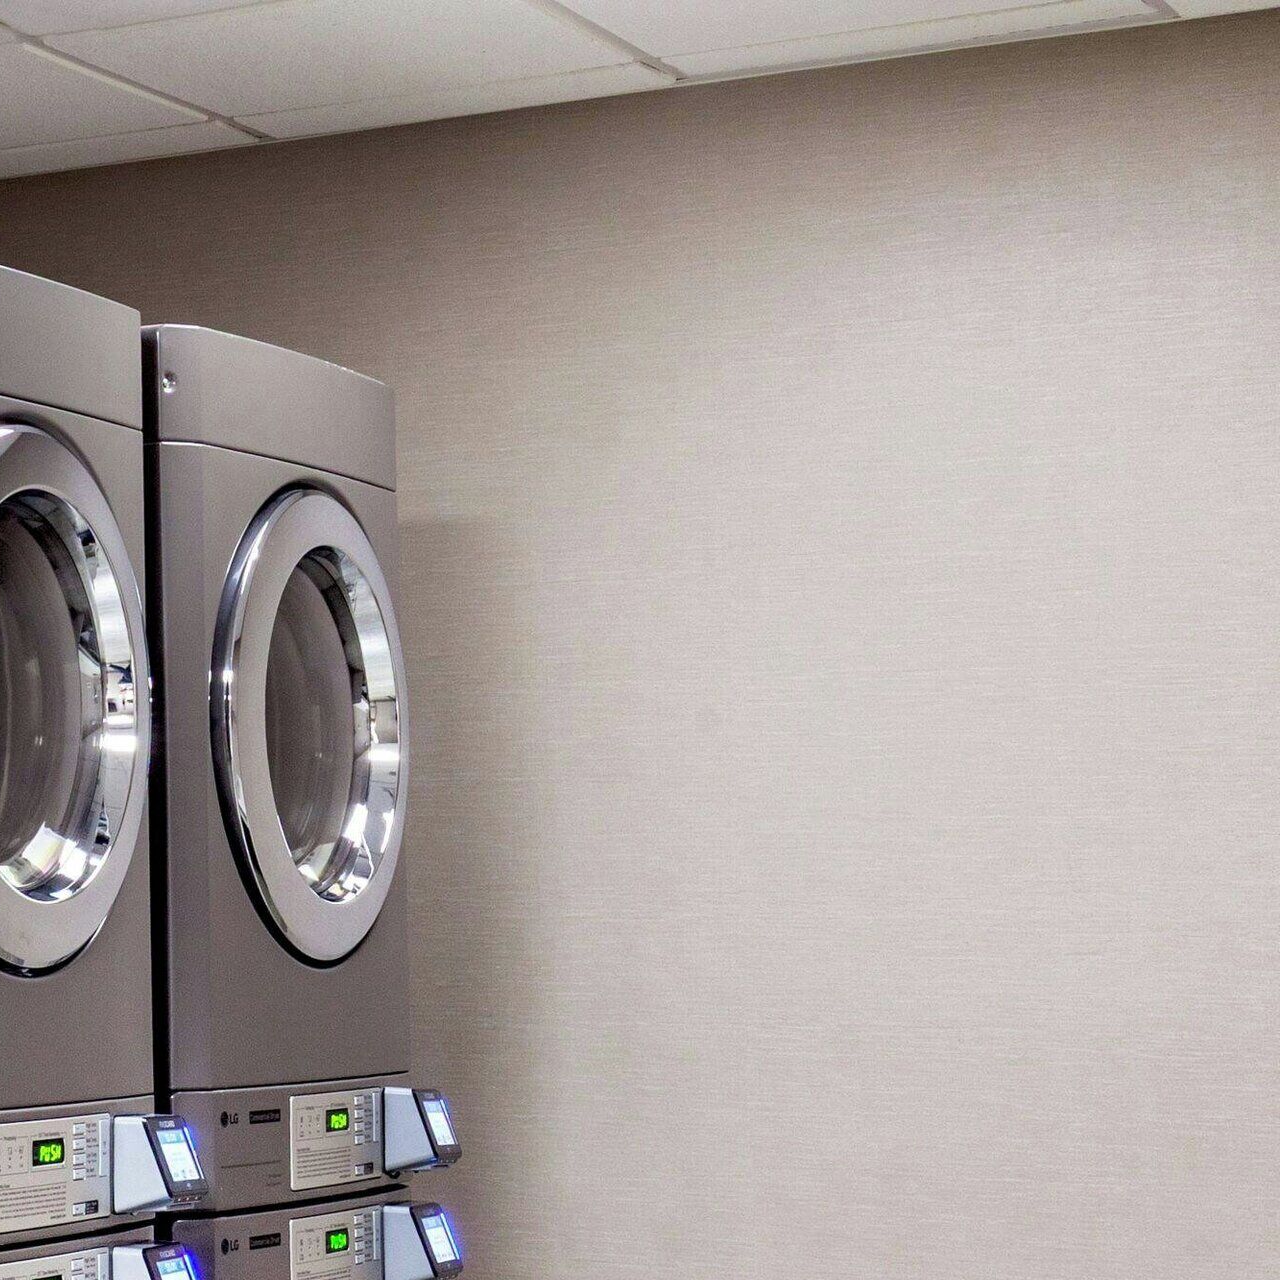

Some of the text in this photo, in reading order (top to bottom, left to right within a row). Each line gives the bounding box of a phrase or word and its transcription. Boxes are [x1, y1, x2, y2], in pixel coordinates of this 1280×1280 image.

[229, 1114, 238, 1124] LG
[40, 1145, 61, 1162] PUSH
[230, 1240, 239, 1251] LG
